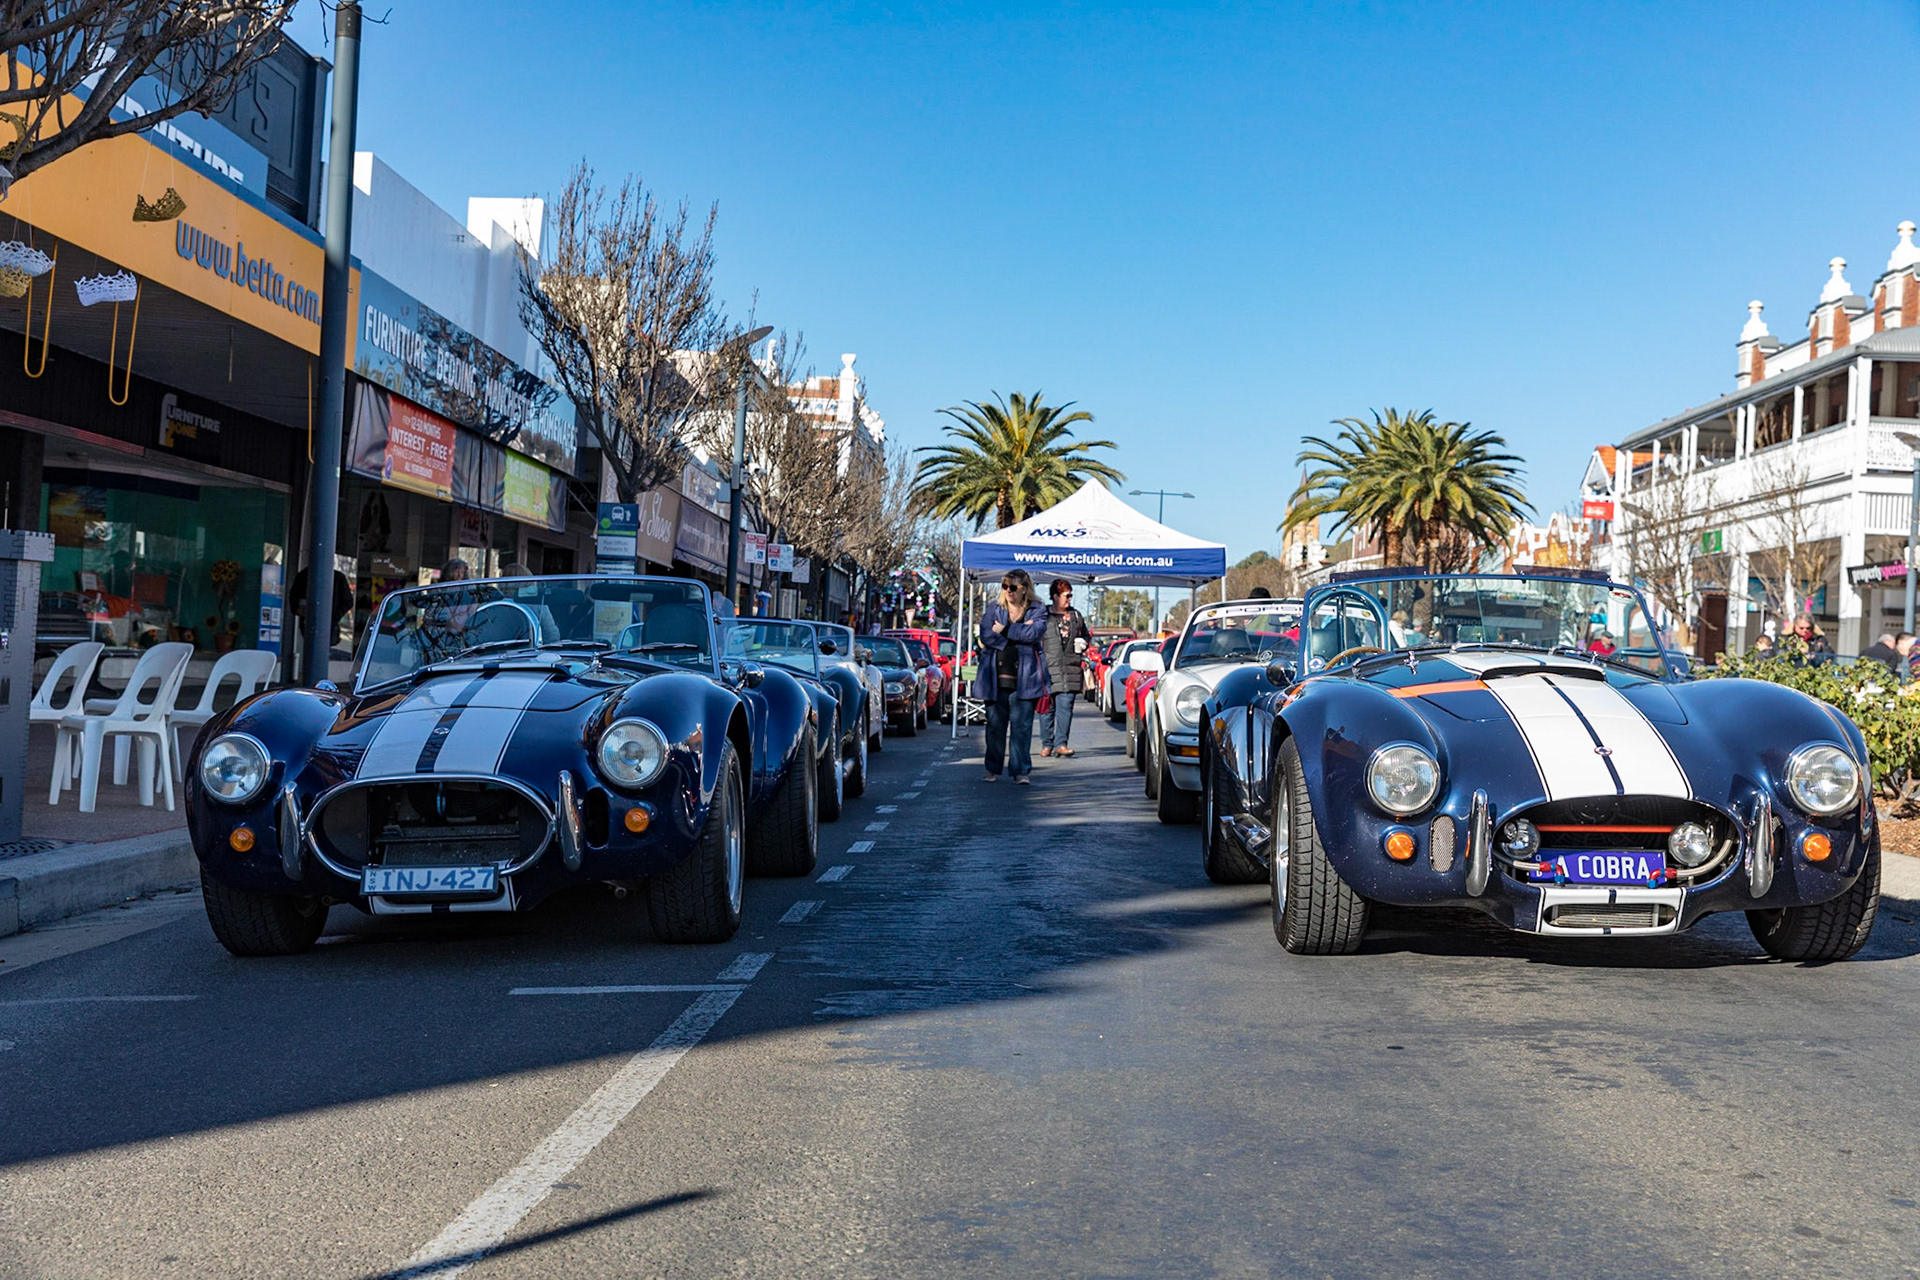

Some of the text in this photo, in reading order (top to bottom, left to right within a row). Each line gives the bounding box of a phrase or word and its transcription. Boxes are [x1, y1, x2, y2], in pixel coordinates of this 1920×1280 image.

[364, 304, 428, 372] FURNITURE
[436, 346, 477, 399] BEDDING
[391, 426, 426, 452] INTEREST
[1029, 528, 1087, 538] MX-5
[1014, 552, 1173, 568] www.mx5clubqld.com.au
[1578, 855, 1651, 880] COBRA
